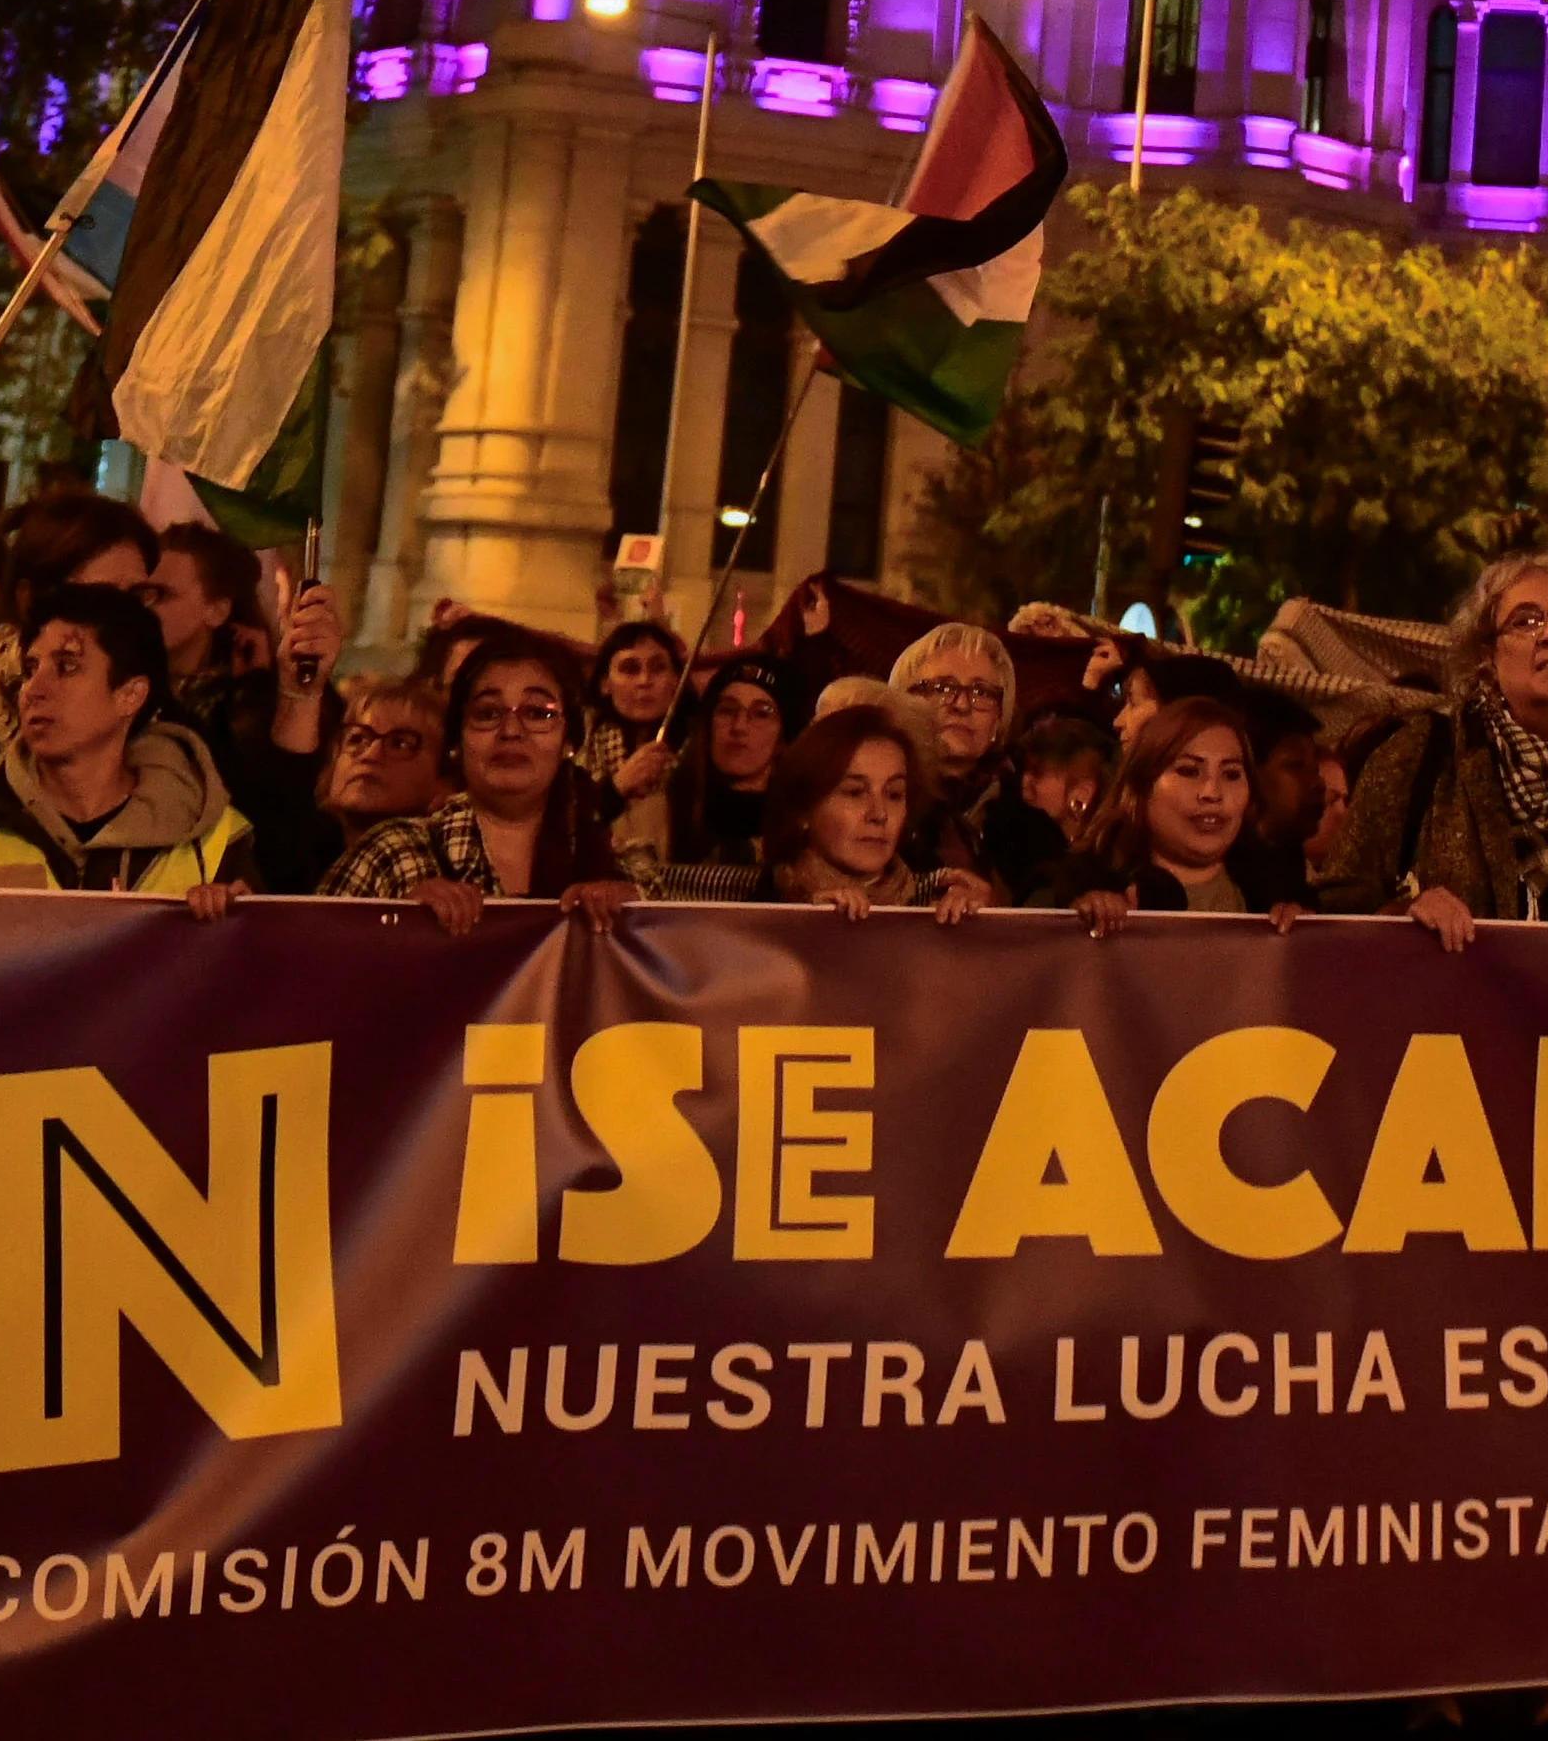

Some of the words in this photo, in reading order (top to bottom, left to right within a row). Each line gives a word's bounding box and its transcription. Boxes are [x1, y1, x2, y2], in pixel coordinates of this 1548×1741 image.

[452, 1022, 875, 1265] ¡SE
[453, 1340, 1006, 1436] NUESTRA
[1054, 1330, 1405, 1421] LUCHA
[465, 1528, 587, 1596] 8M
[624, 1512, 1158, 1589] MOVIMIENTO
